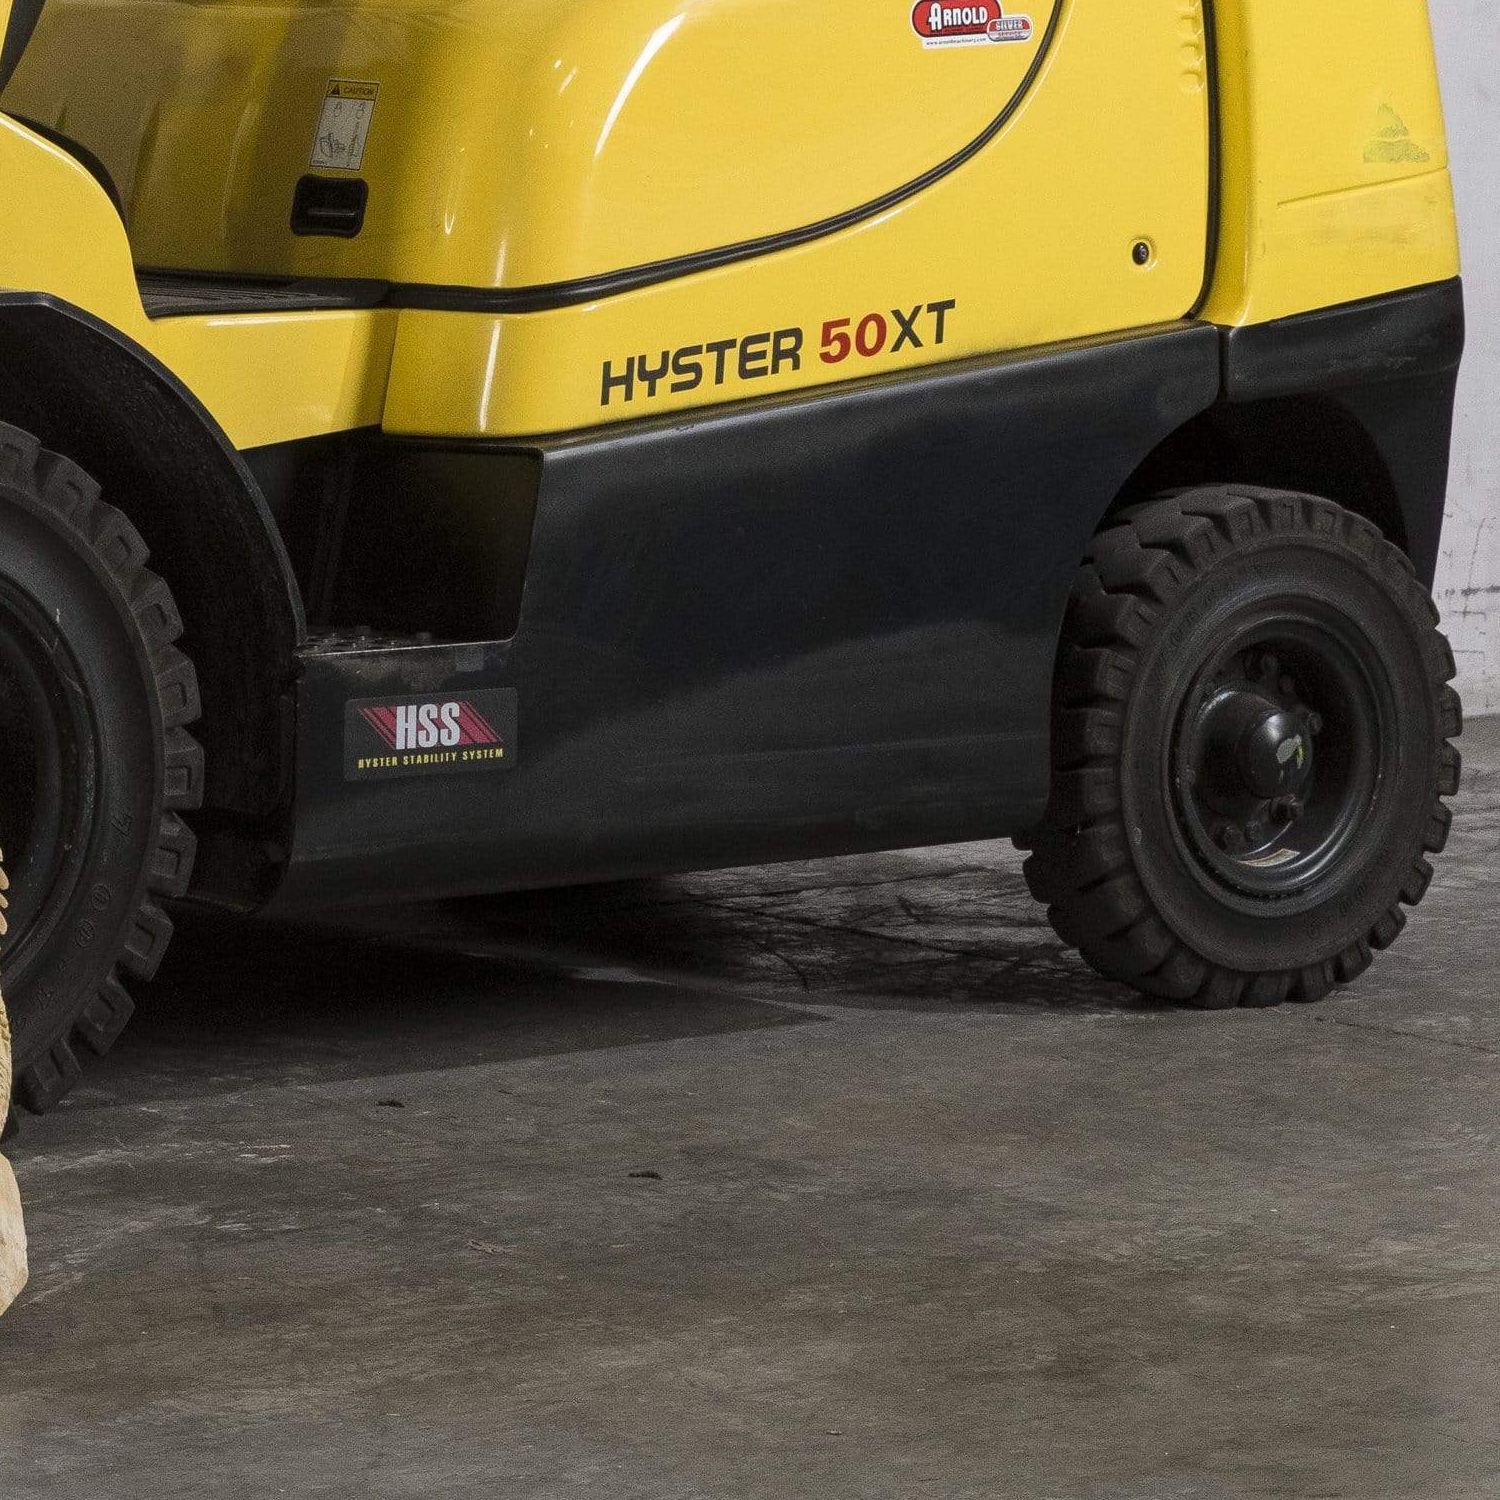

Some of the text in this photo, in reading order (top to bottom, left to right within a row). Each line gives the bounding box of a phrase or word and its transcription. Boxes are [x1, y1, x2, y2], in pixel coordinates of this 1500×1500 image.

[600, 299, 956, 407] HYSTER 50XT
[395, 701, 461, 750] HSS
[357, 748, 504, 769] HYSTER STABILITY SYSTEM
